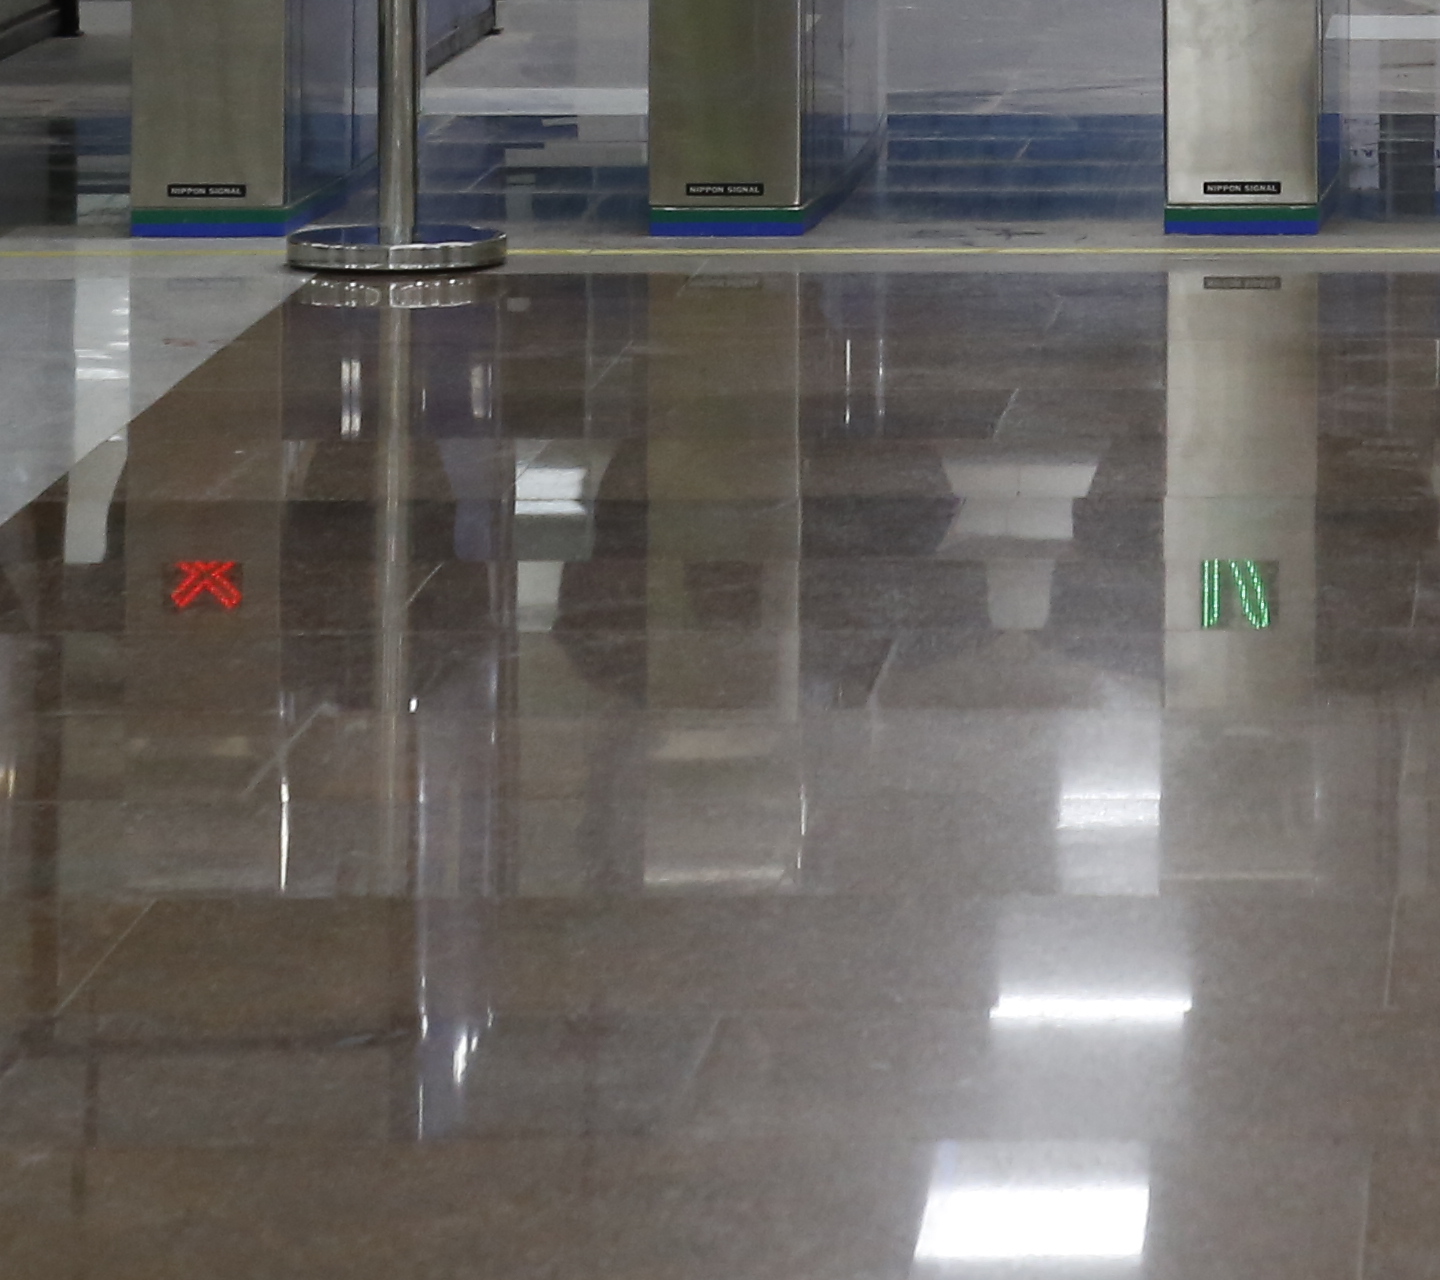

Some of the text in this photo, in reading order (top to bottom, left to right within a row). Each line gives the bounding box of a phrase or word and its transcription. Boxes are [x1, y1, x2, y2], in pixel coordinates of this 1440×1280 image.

[689, 186, 760, 194] NIPPON SIGNAL
[1206, 184, 1278, 192] NIPPON SIGNAL
